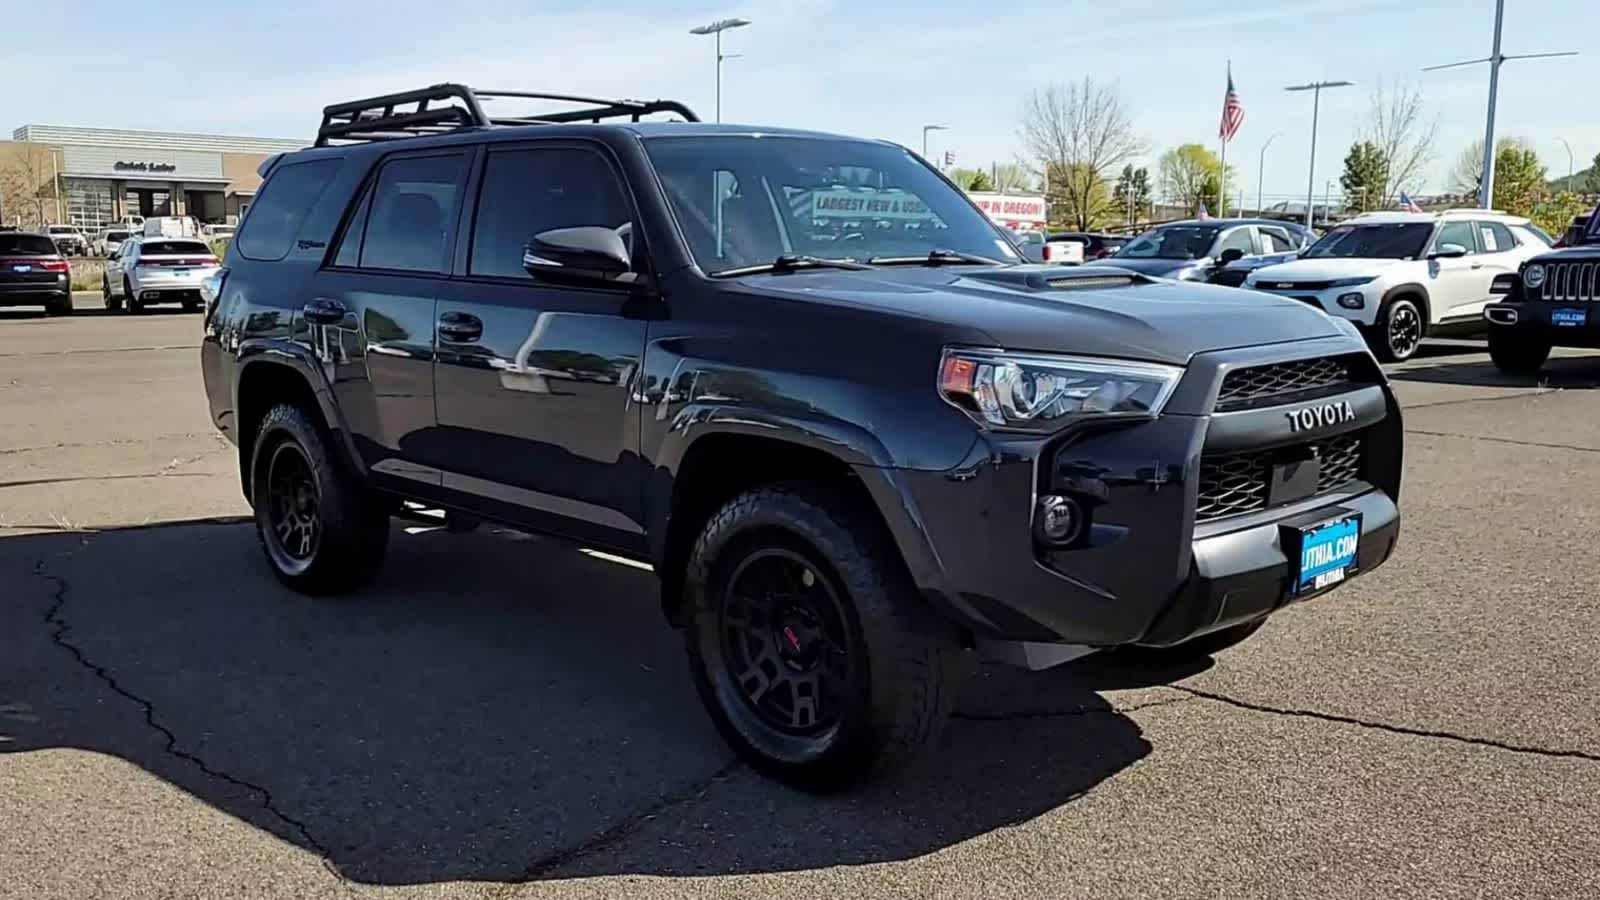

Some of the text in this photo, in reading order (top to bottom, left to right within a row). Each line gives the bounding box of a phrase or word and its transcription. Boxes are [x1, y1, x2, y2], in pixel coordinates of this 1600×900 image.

[817, 199, 864, 211] LARGEST
[1288, 400, 1355, 432] TOYOTA
[1301, 532, 1359, 573] LITHIA.COM
